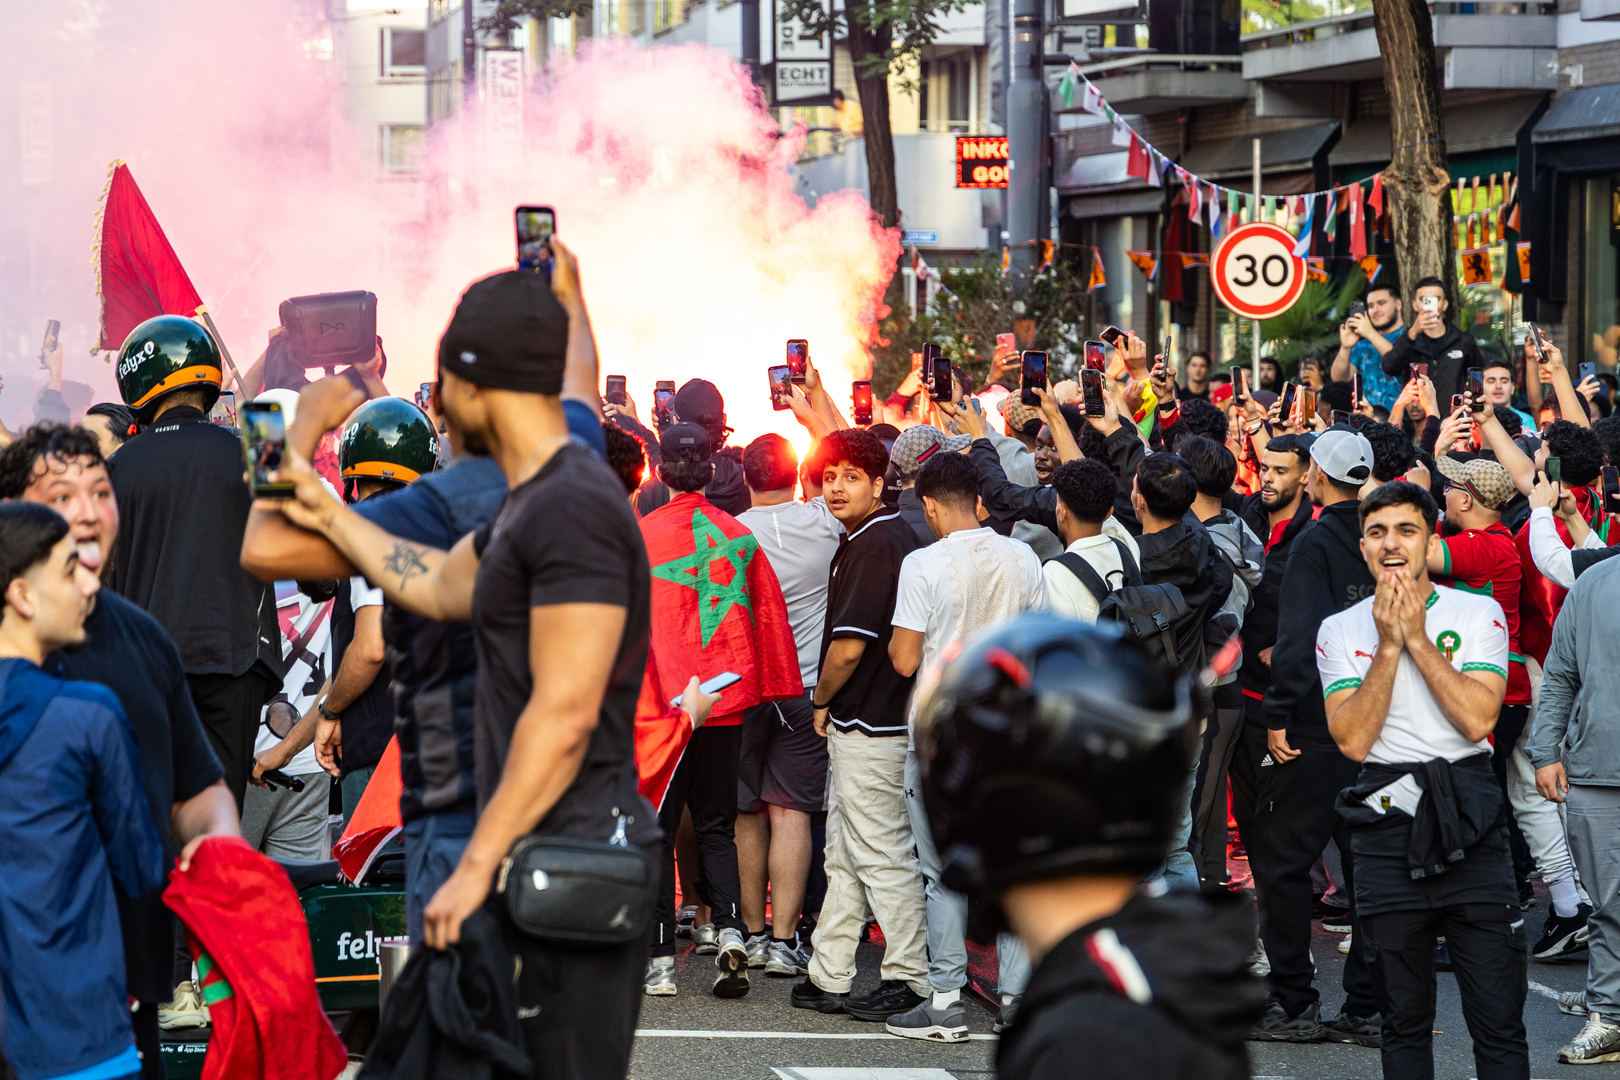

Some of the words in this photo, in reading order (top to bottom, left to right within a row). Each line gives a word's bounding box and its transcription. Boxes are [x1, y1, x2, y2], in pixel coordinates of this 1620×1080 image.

[779, 67, 827, 80] ECHT
[1233, 254, 1289, 287] 30
[119, 349, 147, 379] felyx
[337, 930, 410, 965] fel
